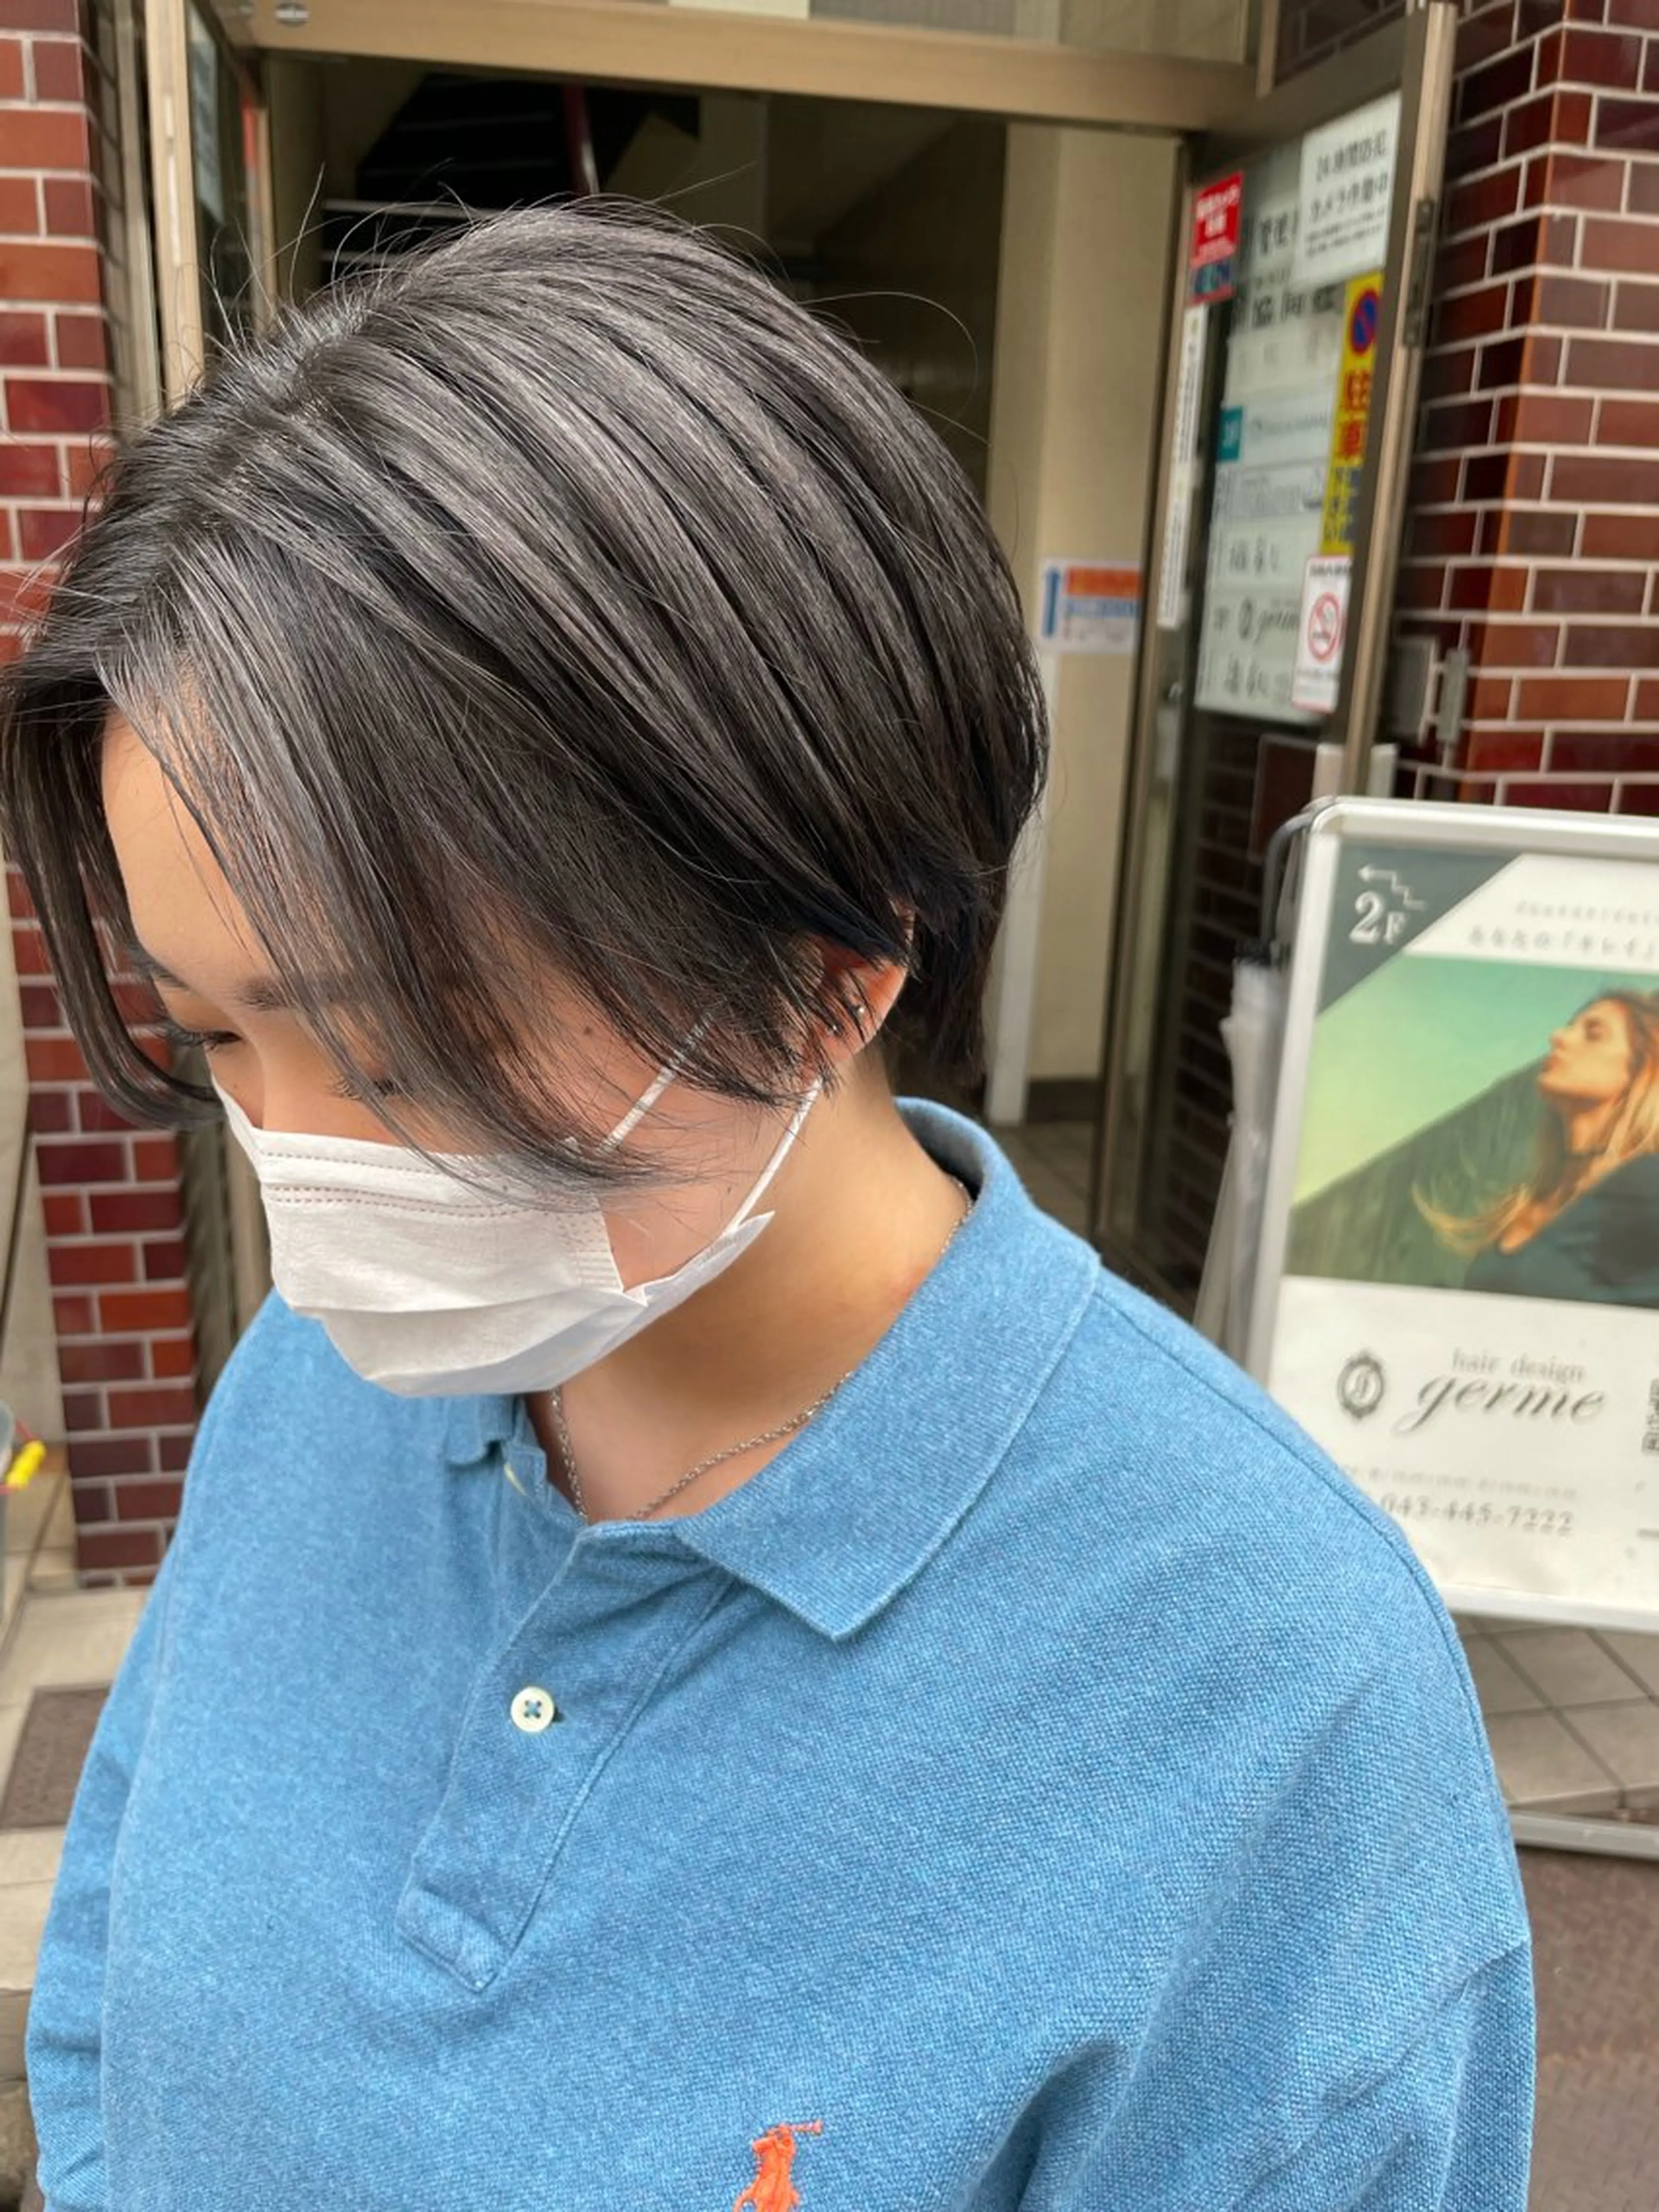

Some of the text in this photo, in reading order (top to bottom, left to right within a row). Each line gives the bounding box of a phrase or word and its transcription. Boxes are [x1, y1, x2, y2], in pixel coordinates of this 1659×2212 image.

[1349, 890, 1409, 945] 2F
[1452, 1347, 1586, 1384] hair design
[1391, 1374, 1606, 1436] germe
